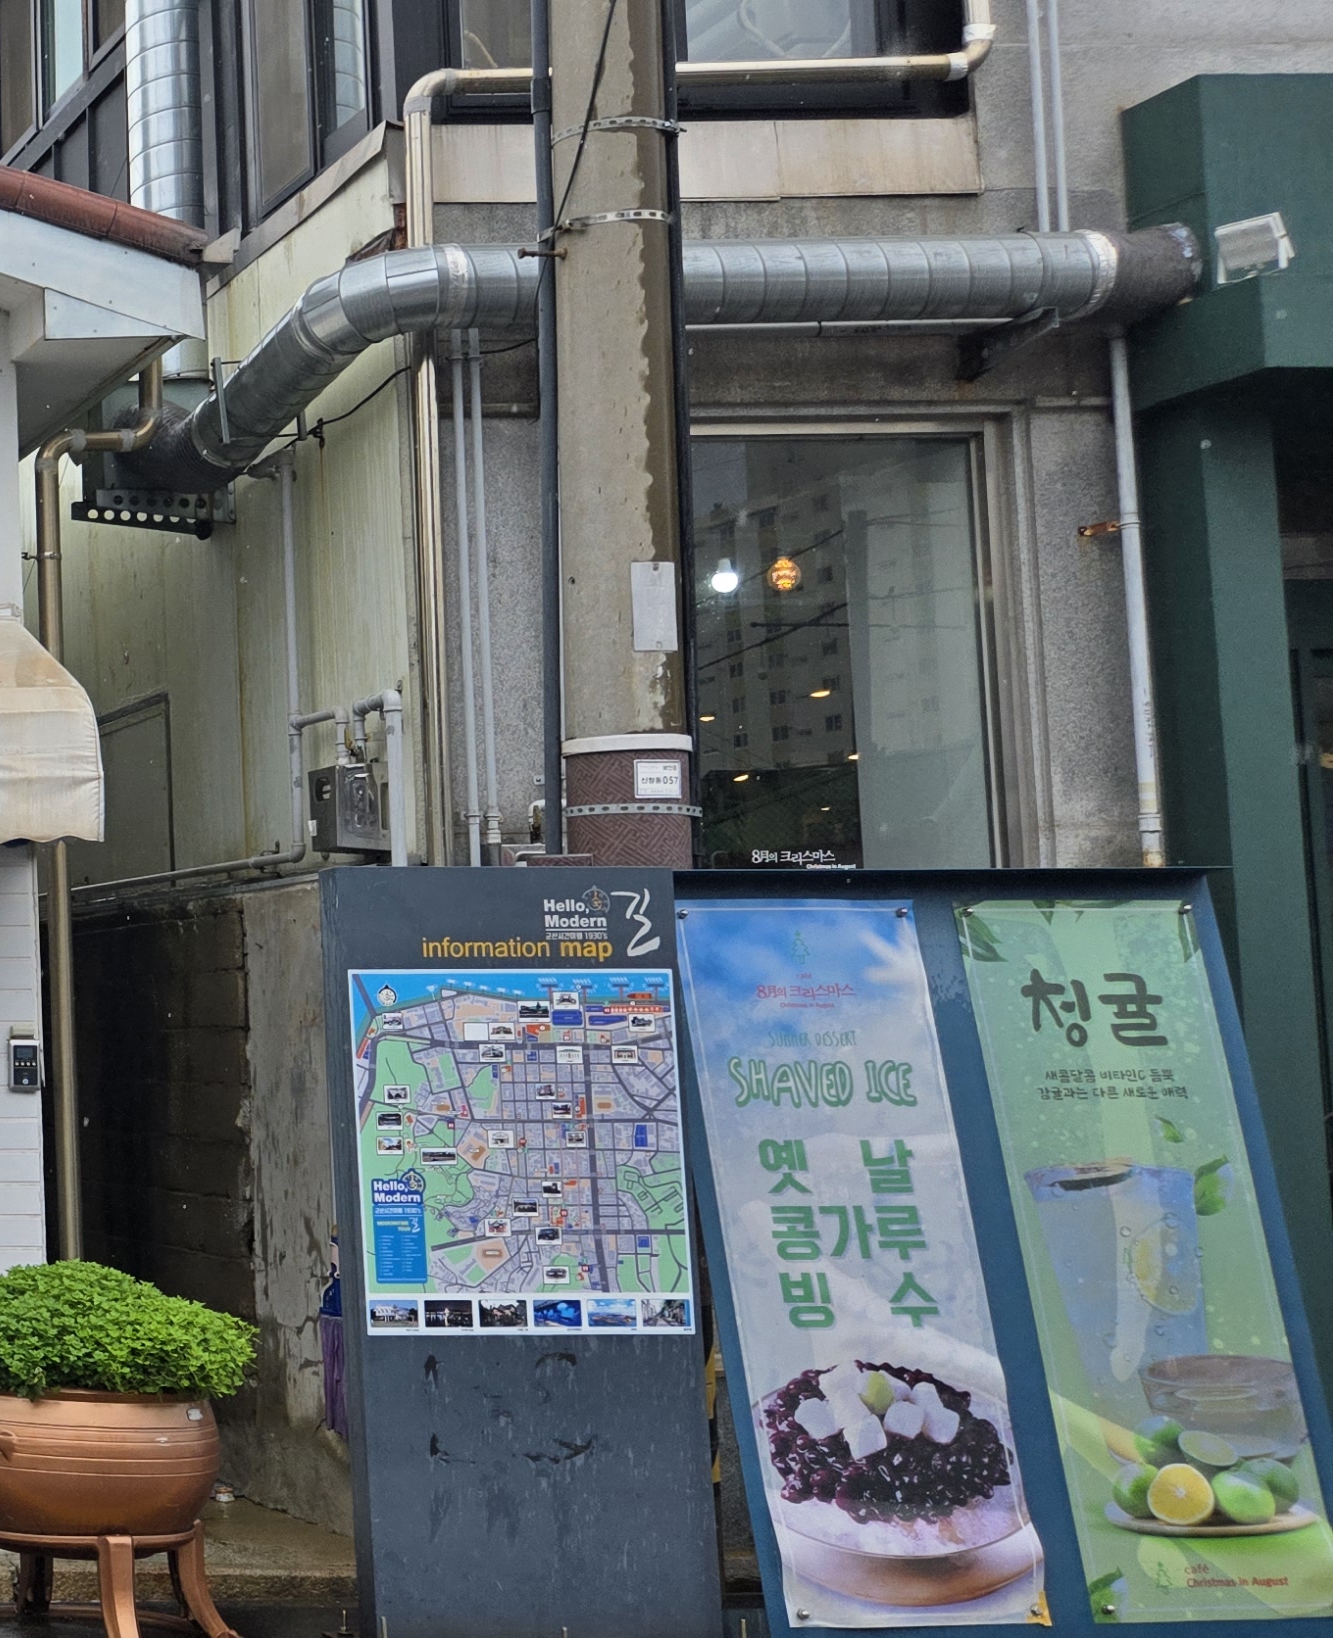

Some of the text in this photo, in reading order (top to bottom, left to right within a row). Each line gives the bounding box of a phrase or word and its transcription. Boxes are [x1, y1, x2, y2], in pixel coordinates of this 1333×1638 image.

[662, 776, 678, 785] 057
[780, 849, 836, 865] 크리스마스
[543, 899, 590, 914] Hello,
[544, 914, 607, 928] Modern
[422, 937, 613, 962] information map
[789, 983, 856, 999] 크리스마스
[1021, 968, 1168, 1047] 청귤
[768, 1030, 858, 1047] SUMMER DESSERT
[729, 1055, 918, 1108] SHAVED ICE
[1045, 1068, 1174, 1083] 새콤달콤 비타민C 듬뿍
[1037, 1086, 1089, 1100] 감귤과는
[1093, 1086, 1118, 1099] 다른
[1123, 1086, 1158, 1099] 새로운
[758, 1138, 914, 1194] 옛날
[373, 1180, 409, 1193] Hello,
[374, 1192, 421, 1203] Modern
[770, 1204, 926, 1260] 콩가루
[779, 1271, 940, 1328] 빙수
[1187, 1577, 1288, 1588] Christmas in August
